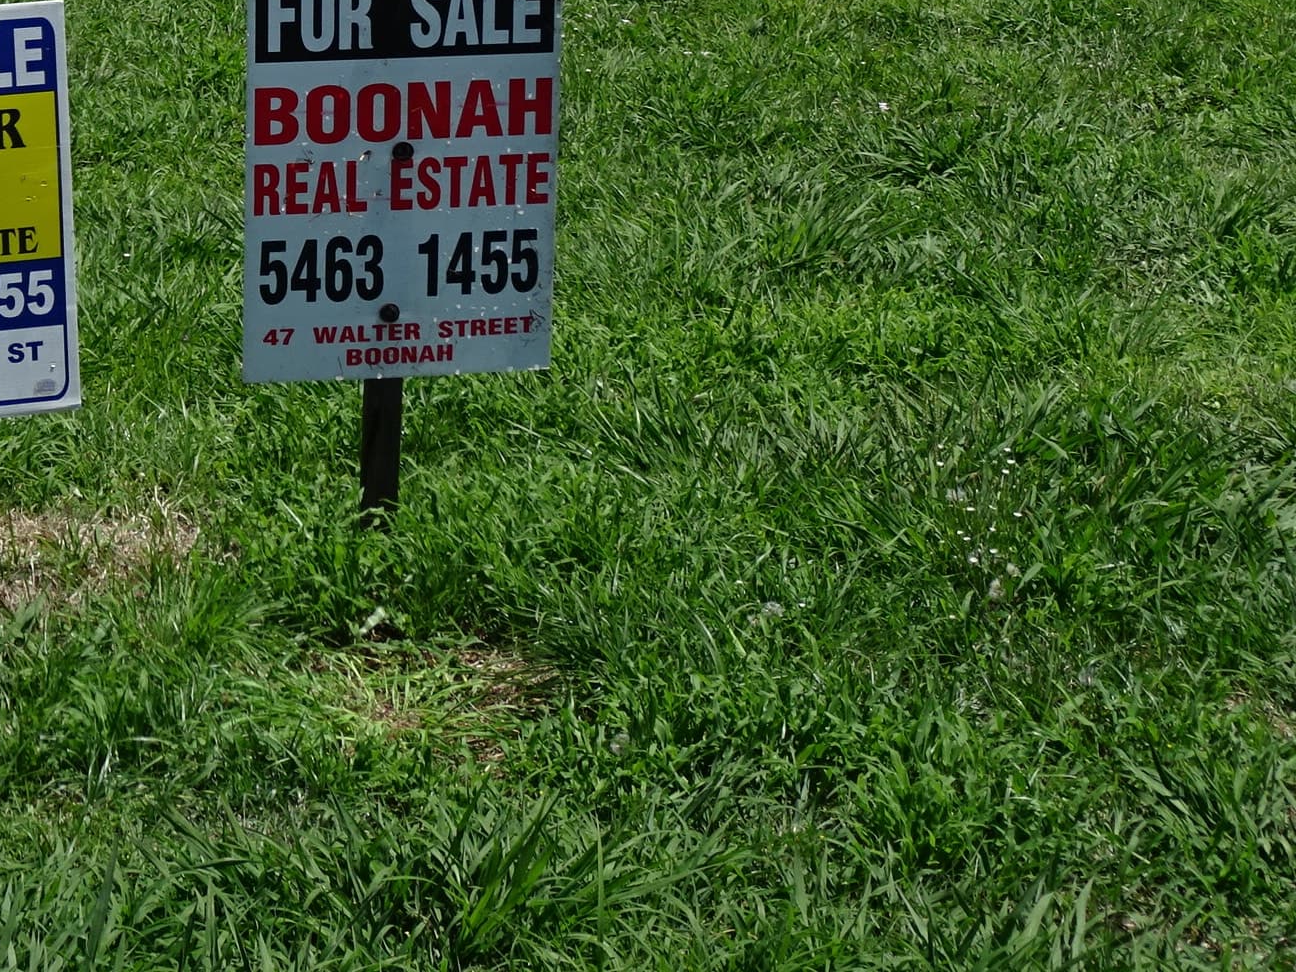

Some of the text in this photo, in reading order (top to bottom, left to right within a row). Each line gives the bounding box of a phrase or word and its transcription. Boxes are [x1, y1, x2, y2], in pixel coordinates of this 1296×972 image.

[254, 78, 552, 146] BOONAH
[254, 153, 550, 216] REAL ESTATE
[259, 228, 538, 305] 5463 1455
[8, 341, 43, 363] ST
[263, 316, 533, 346] 47 WALTER STREET
[346, 344, 453, 366] BOONAH
